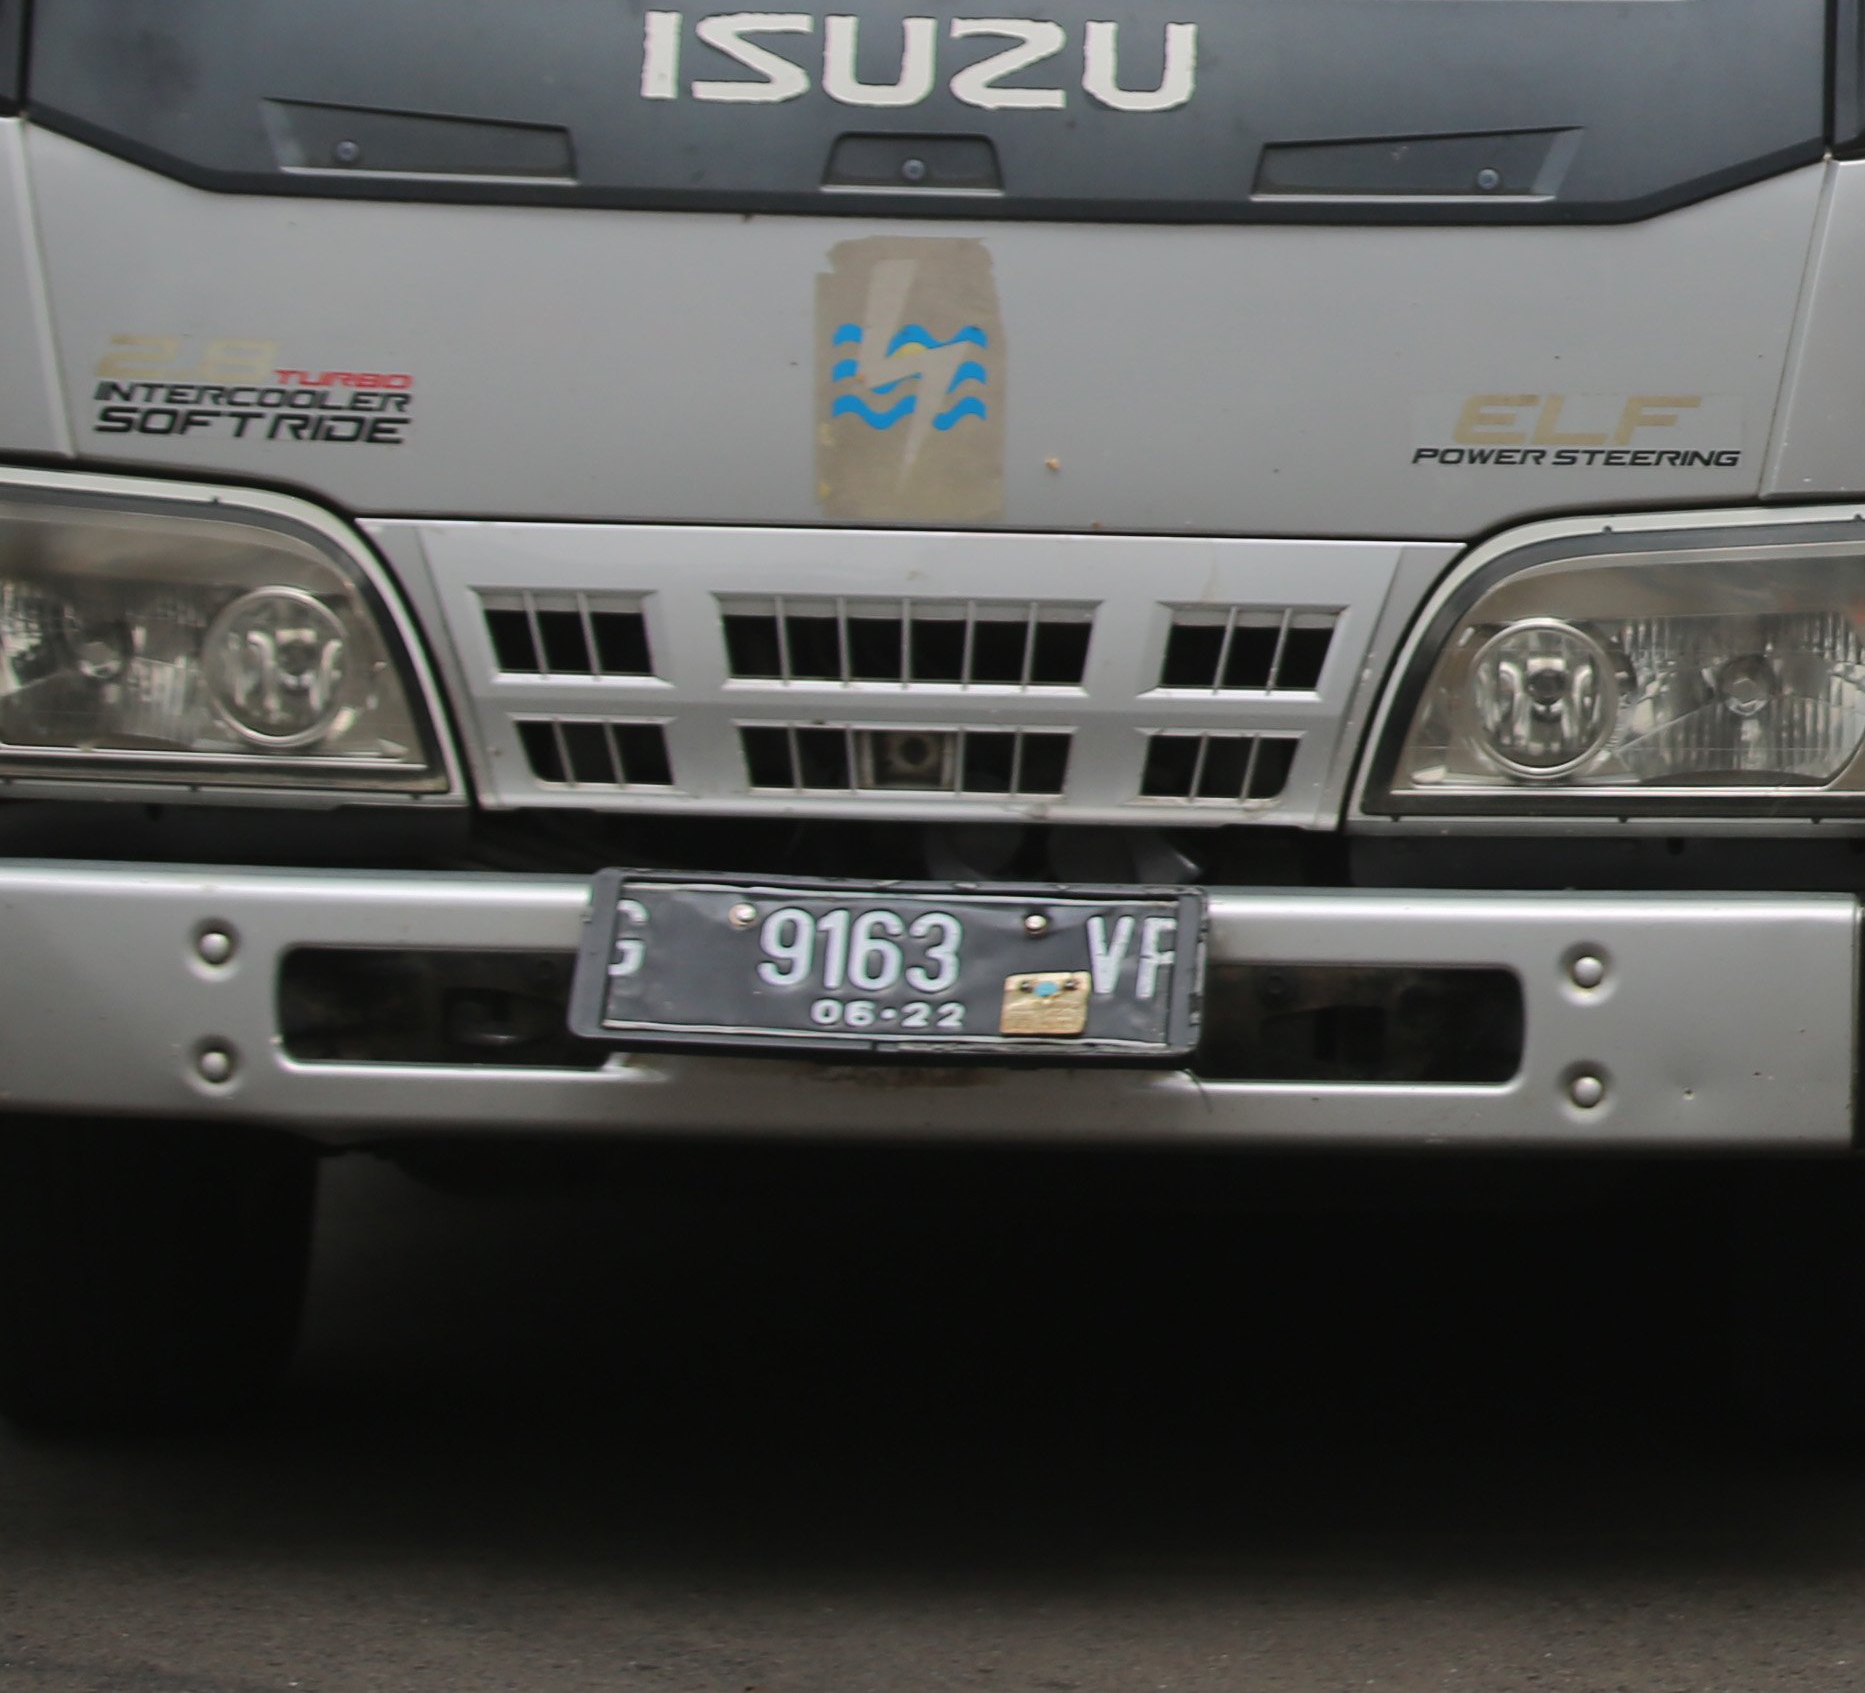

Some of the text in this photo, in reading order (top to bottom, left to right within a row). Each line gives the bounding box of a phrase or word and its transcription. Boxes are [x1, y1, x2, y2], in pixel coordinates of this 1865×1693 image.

[641, 9, 1198, 111] ISUZU
[93, 380, 413, 413] INTERCOOLER
[275, 368, 414, 390] TURBO
[1452, 393, 1702, 446] ELF
[1411, 448, 1742, 467] POWER STEERING
[757, 906, 962, 994] 9163
